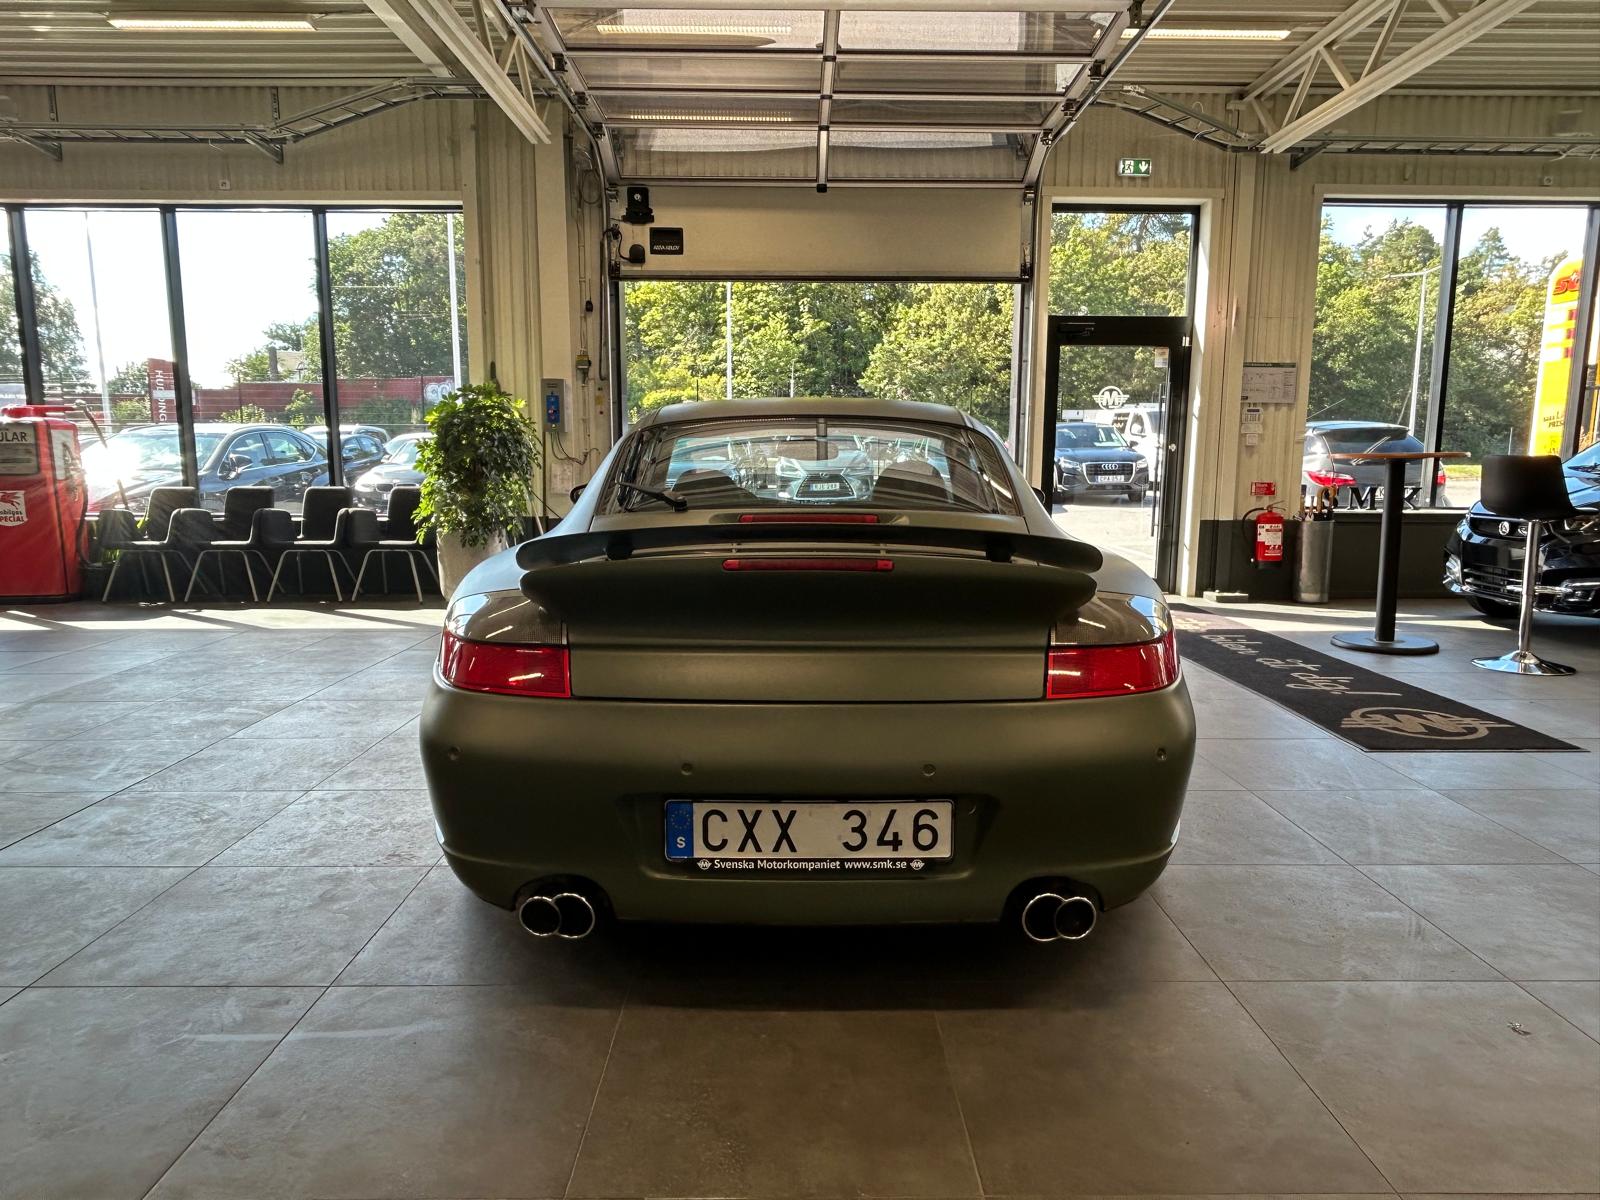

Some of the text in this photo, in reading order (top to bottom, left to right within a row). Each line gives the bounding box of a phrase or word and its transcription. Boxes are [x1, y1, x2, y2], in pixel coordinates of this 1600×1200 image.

[702, 809, 939, 853] CXX 346
[676, 836, 687, 849] S
[714, 859, 755, 869] Svenska
[757, 860, 841, 871] Motorkompaniet
[844, 859, 907, 869] www.smk.se
